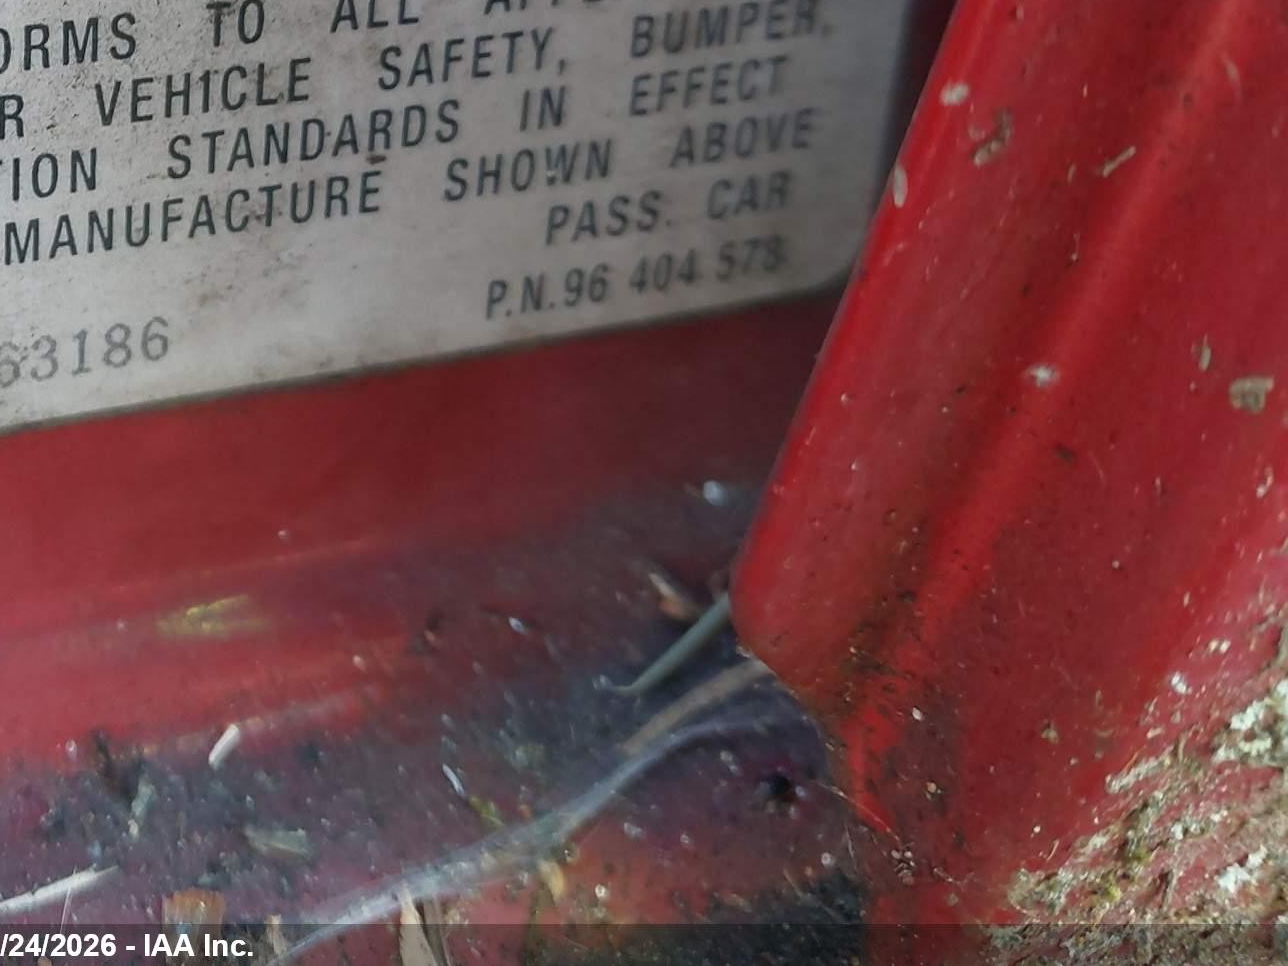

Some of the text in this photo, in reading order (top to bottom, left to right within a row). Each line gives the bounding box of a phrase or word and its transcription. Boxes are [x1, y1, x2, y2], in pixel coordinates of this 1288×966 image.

[378, 27, 566, 91] SAFETY,
[168, 101, 459, 180] STANDARDS
[520, 87, 565, 131] IN
[629, 55, 789, 117] EFFECT
[4, 171, 381, 266] MANUFACTURE
[445, 138, 613, 202] SHOWN
[670, 108, 817, 168] ABOVE
[708, 169, 791, 219] CAR
[629, 249, 698, 294] 404
